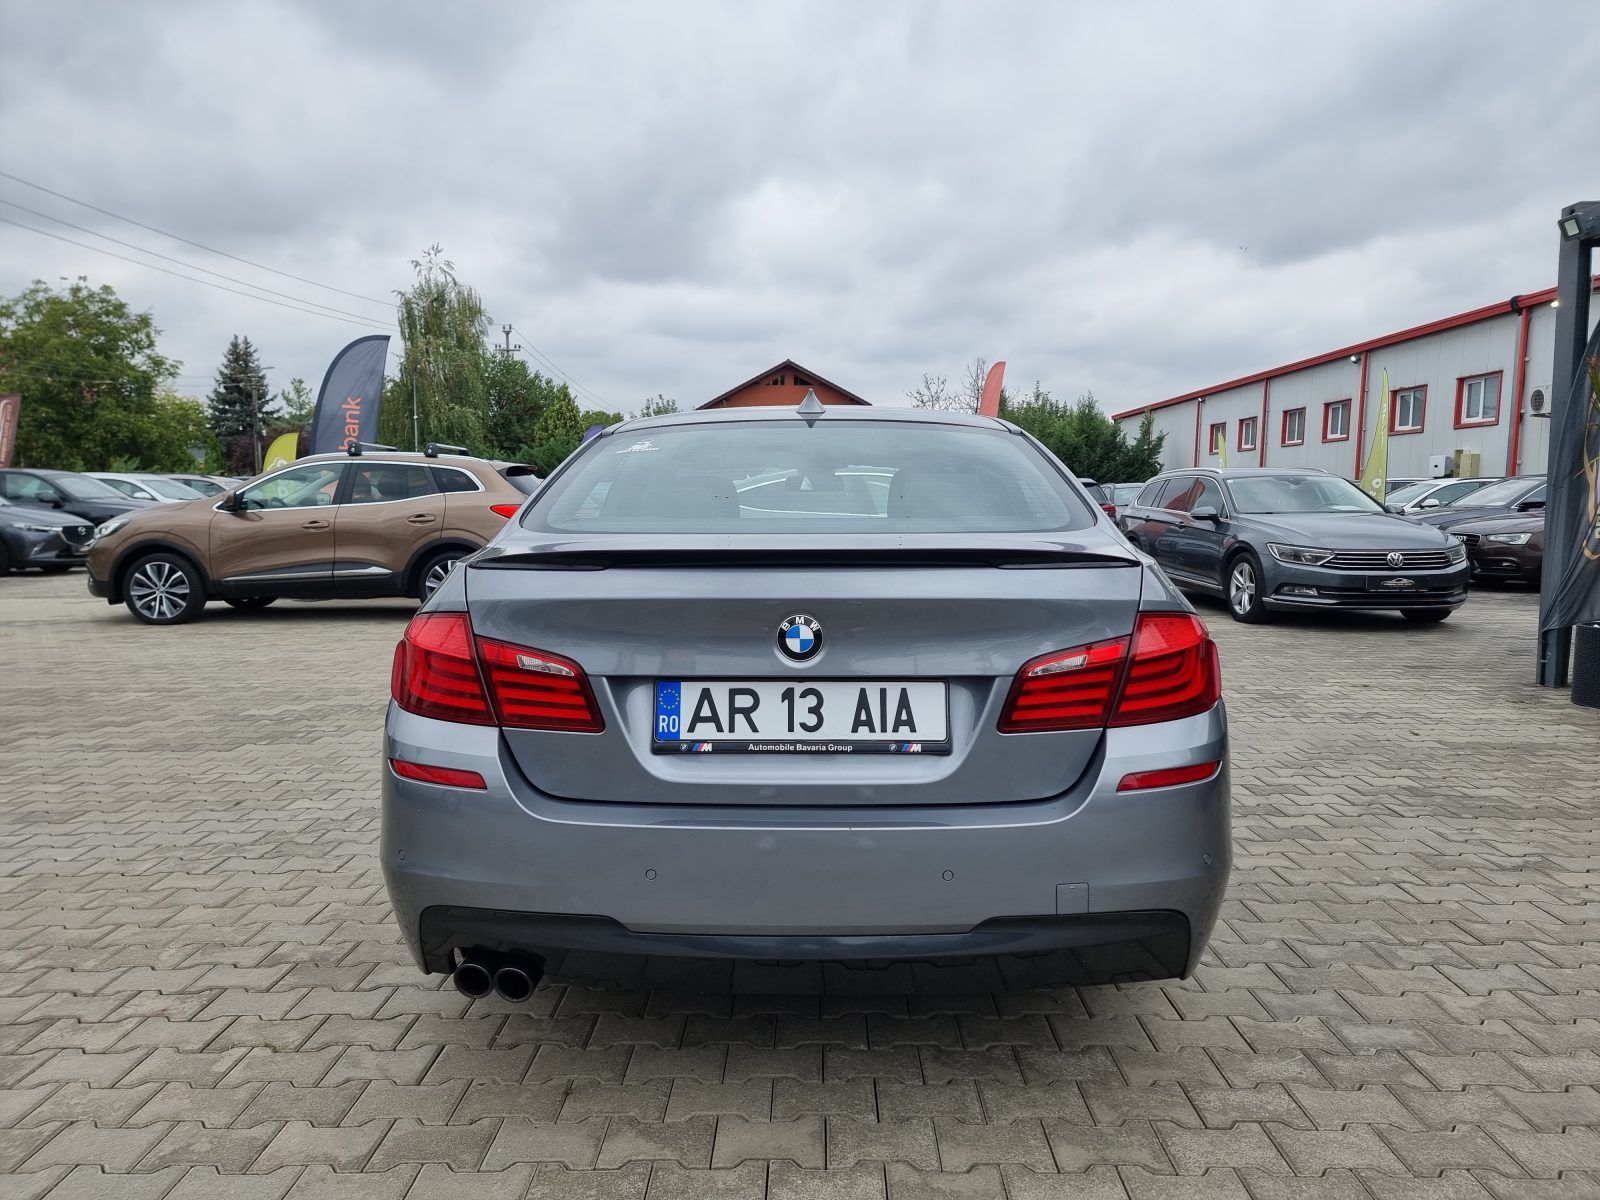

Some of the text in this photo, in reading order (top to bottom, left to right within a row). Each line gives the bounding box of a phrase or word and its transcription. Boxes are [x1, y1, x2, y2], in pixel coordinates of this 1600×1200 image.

[338, 397, 361, 450] bank
[781, 616, 820, 631] BMW
[686, 687, 918, 733] AR 13 AIA
[659, 715, 679, 733] RO
[748, 743, 853, 753] Automobile Bavaria Group
